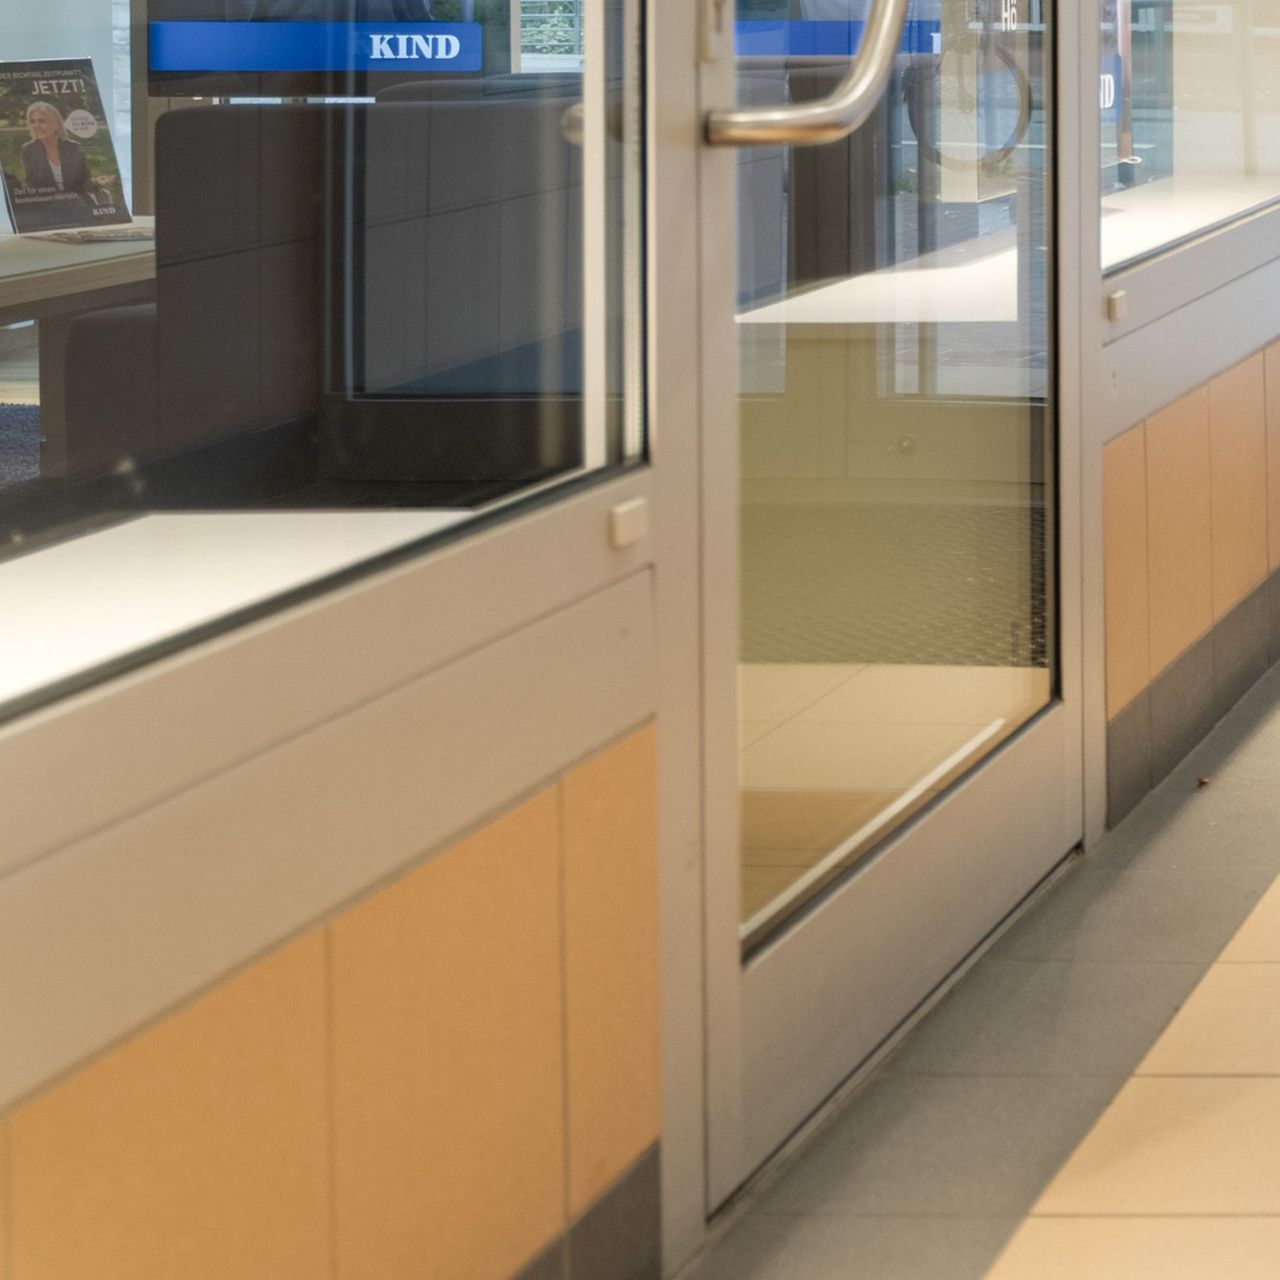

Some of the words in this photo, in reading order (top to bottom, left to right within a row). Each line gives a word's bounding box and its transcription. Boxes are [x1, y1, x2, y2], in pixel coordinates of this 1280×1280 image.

[369, 34, 460, 60] KIND
[32, 79, 86, 95] JETZT!
[93, 207, 116, 216] KIND
